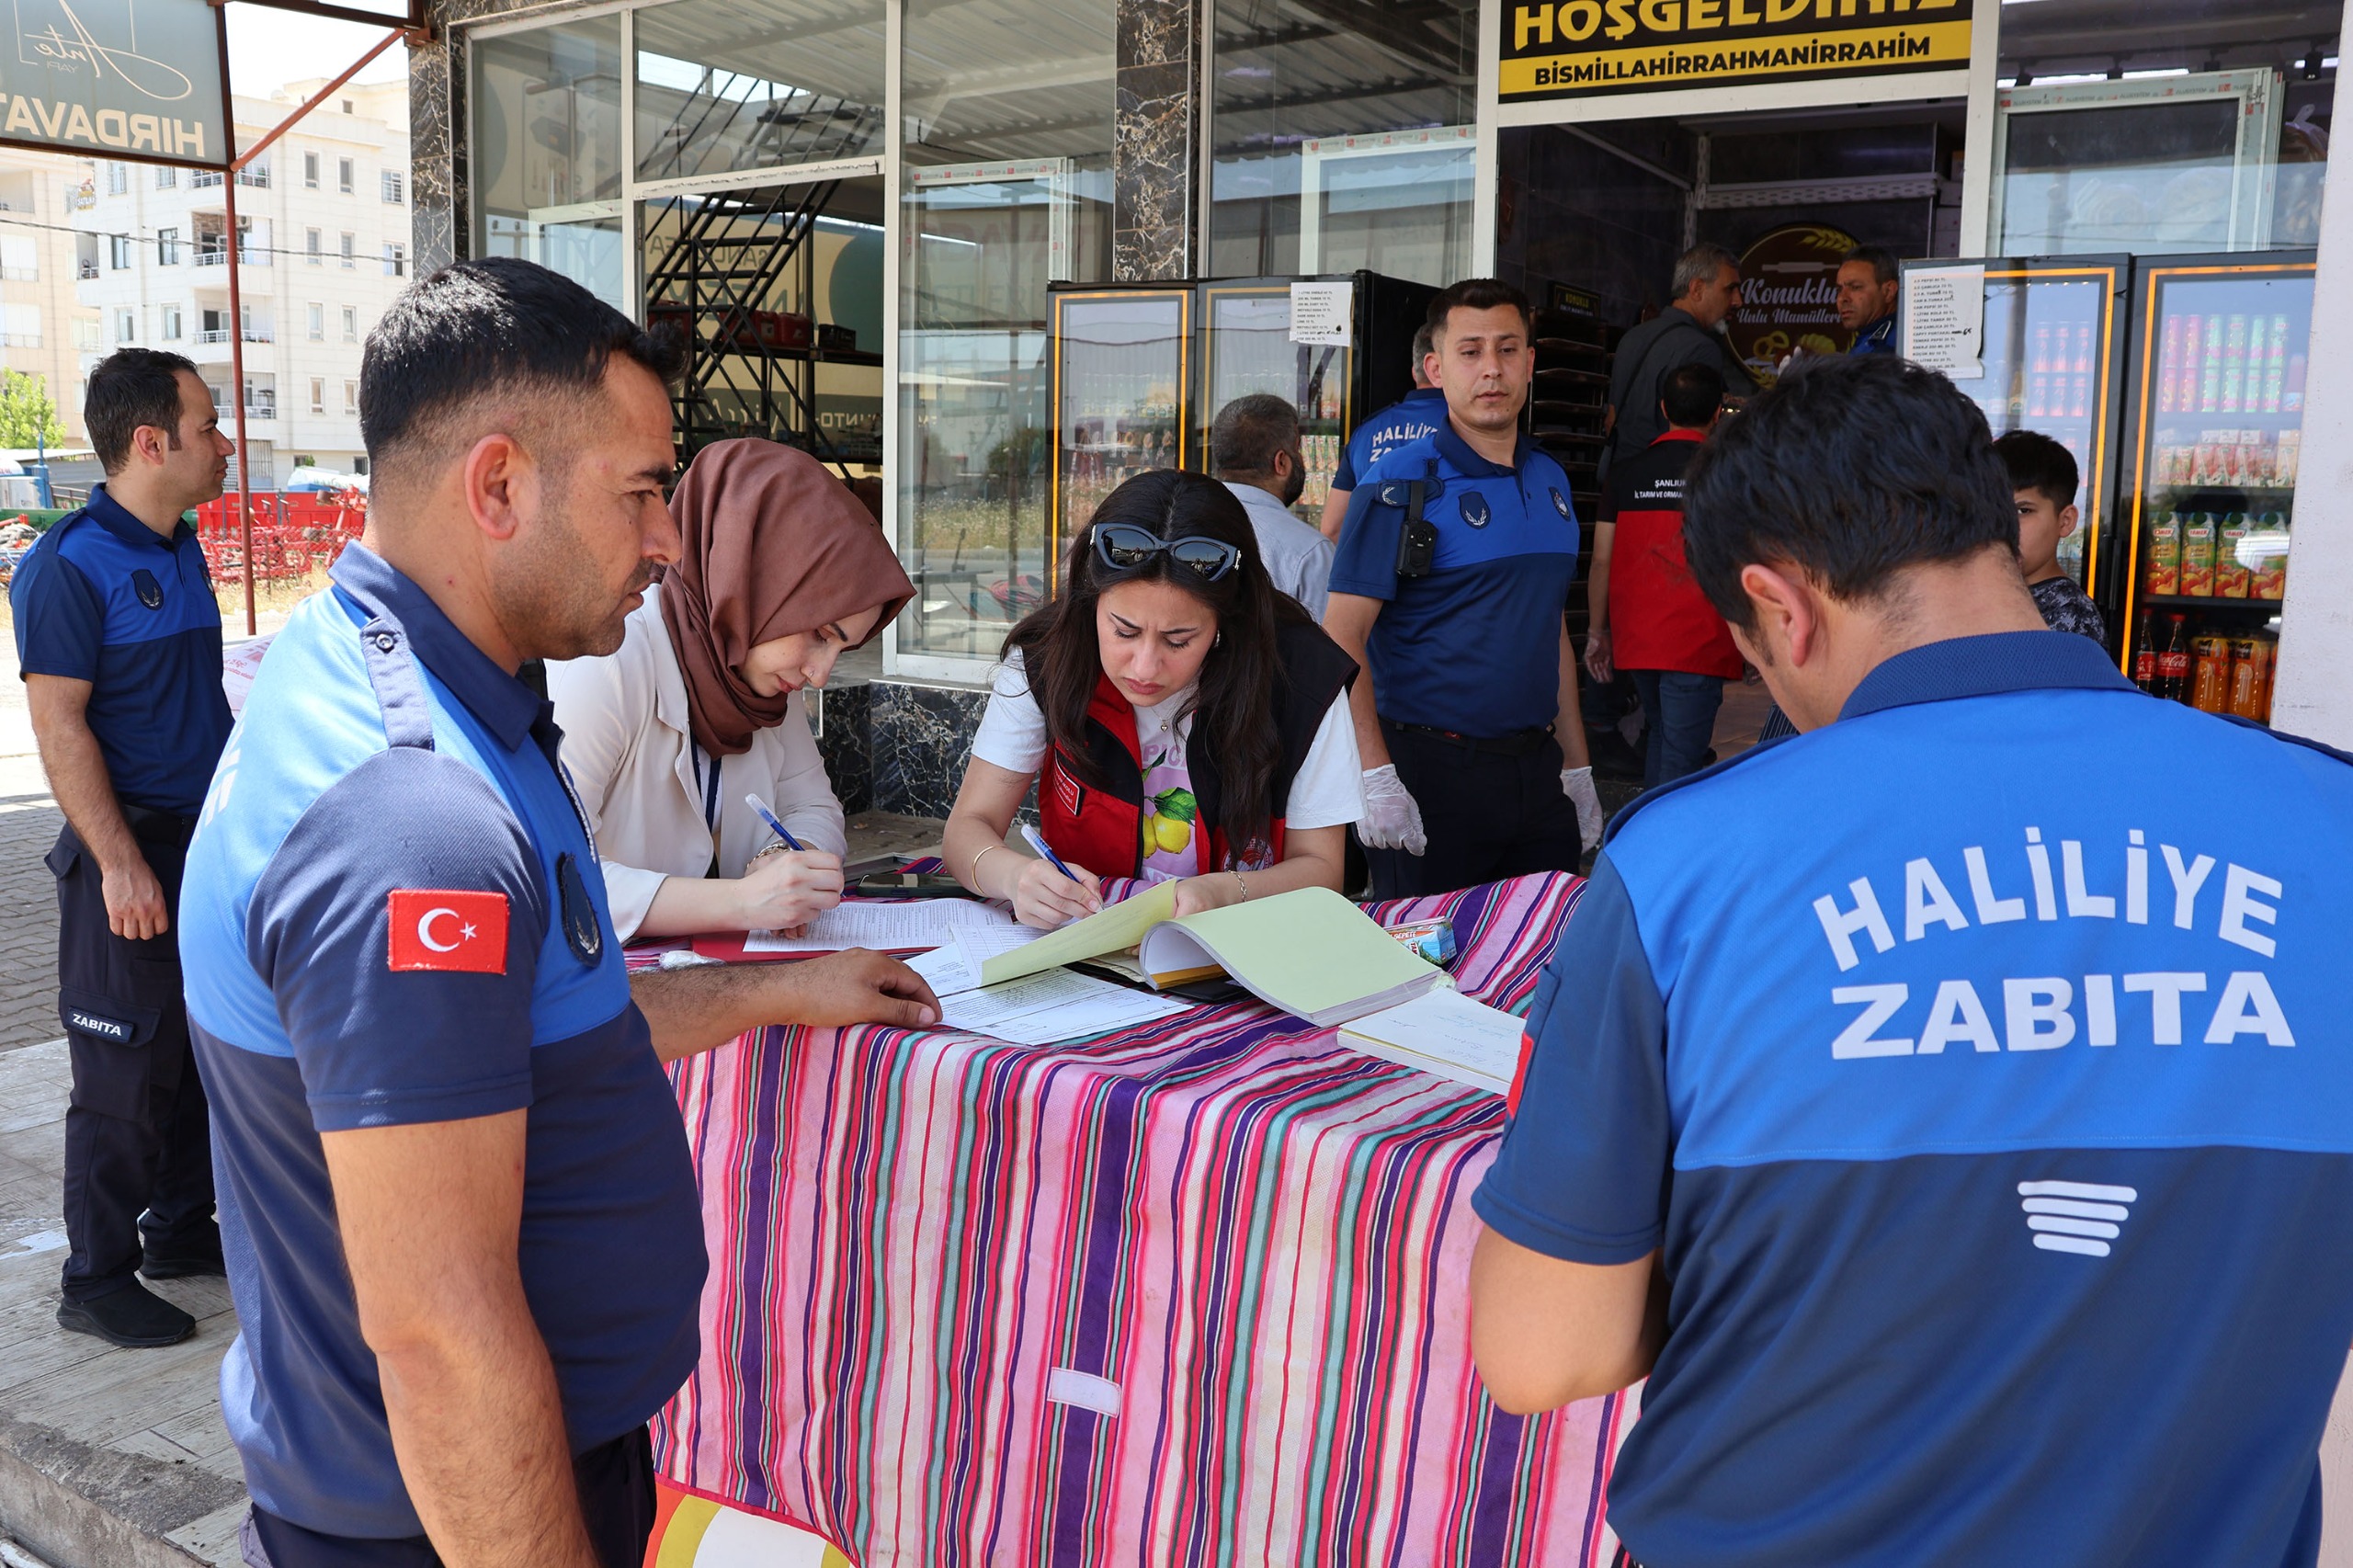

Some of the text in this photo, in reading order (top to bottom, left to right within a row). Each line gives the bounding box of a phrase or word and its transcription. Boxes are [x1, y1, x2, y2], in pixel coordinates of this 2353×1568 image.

[1514, 0, 1957, 51] HOŞGELD
[1535, 31, 1930, 85] BİSMİLLAHİRRAHMANİRRAHİM
[1740, 278, 1838, 305] Konuklu
[1813, 826, 2282, 972] HALİLİYE
[73, 1013, 122, 1037] ZABITA
[1832, 971, 2296, 1060] ZABITA
